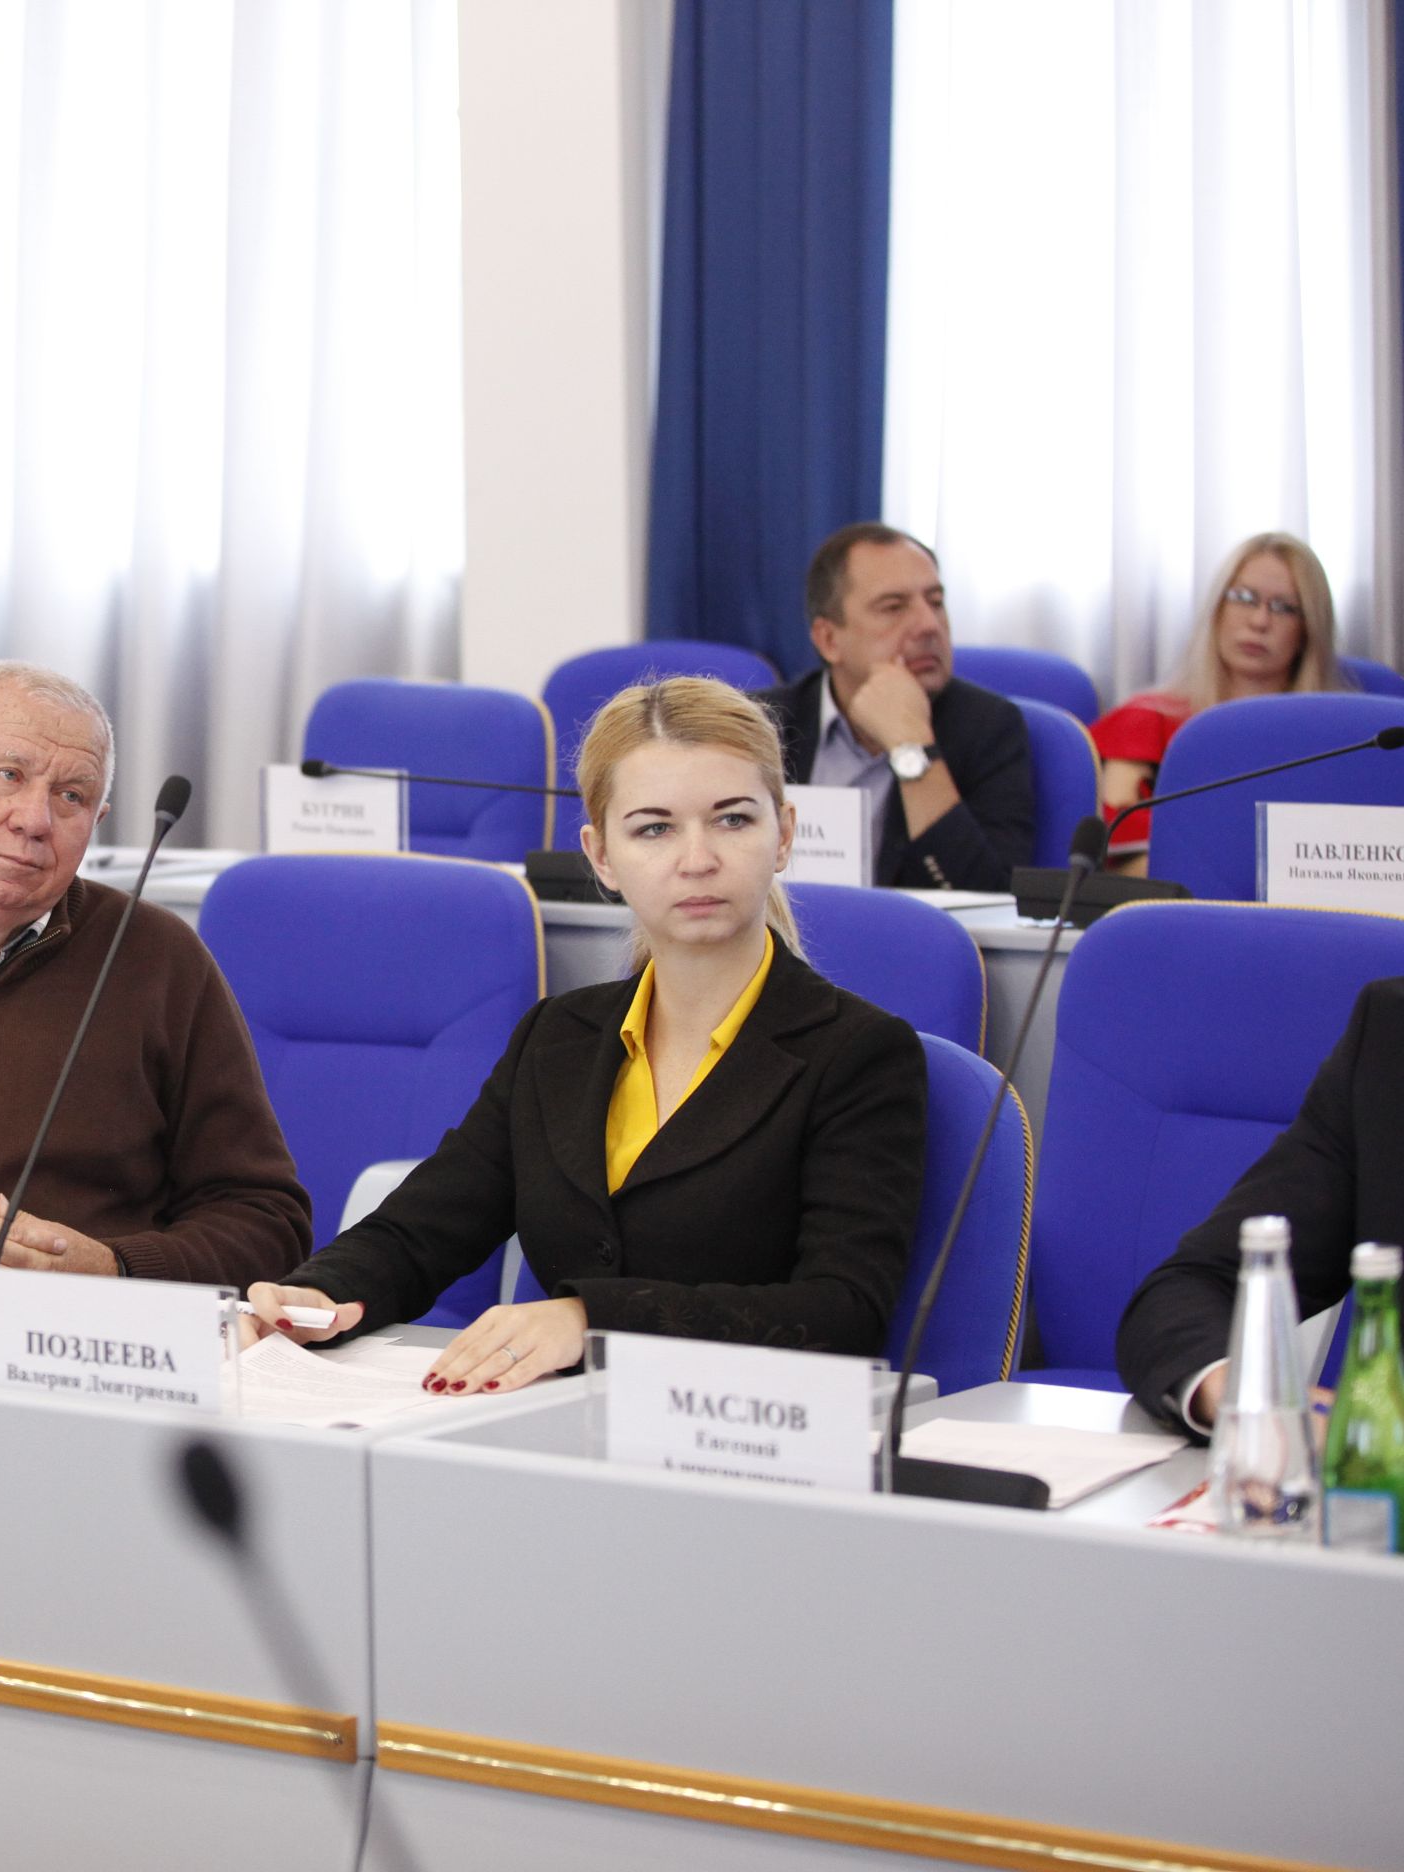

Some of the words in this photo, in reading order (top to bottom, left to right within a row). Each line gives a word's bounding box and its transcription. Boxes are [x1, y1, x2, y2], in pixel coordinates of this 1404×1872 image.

[1288, 866, 1344, 880] Наталья
[1347, 868, 1404, 882] Яковлев
[25, 1330, 177, 1373] ПОЗДЕЕВА
[6, 1364, 81, 1391] Валерия
[85, 1375, 200, 1405] Дмитриевна
[667, 1387, 808, 1431] МАСЛОВ
